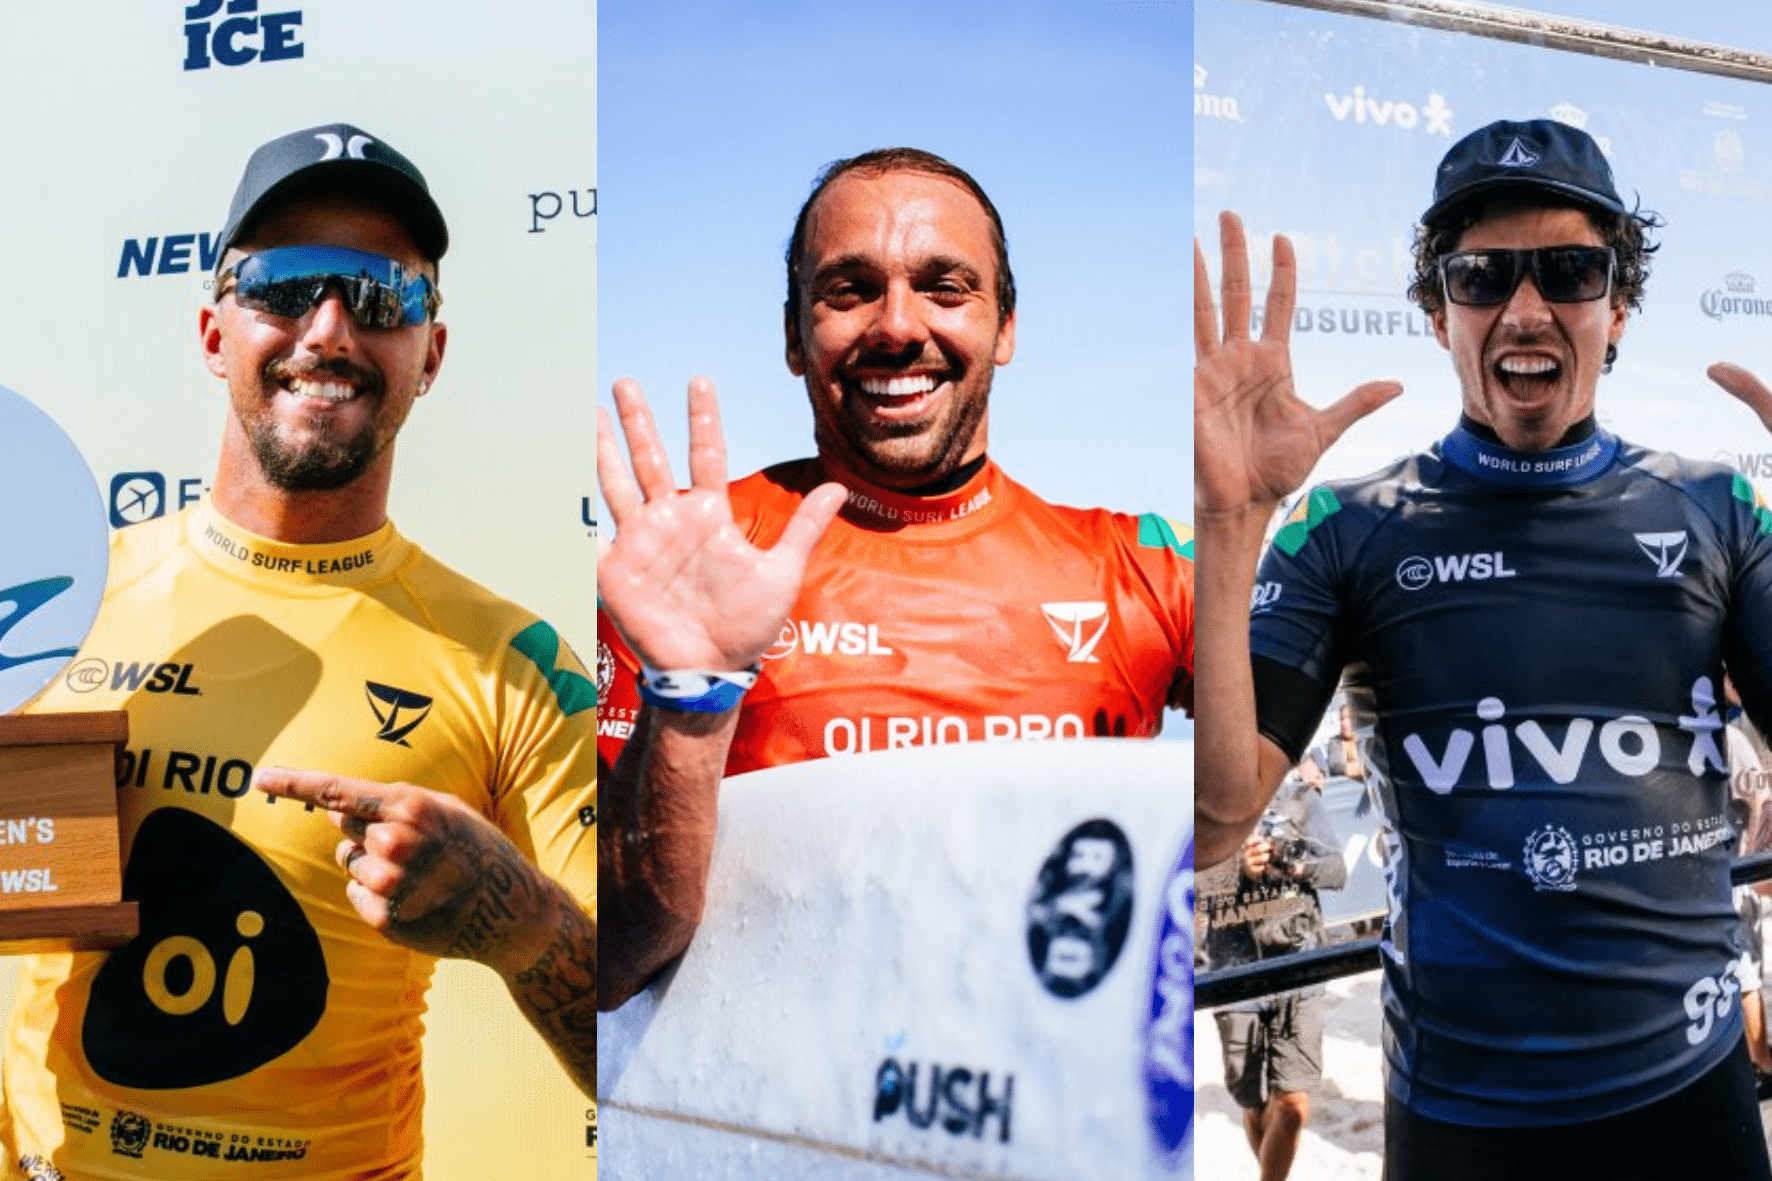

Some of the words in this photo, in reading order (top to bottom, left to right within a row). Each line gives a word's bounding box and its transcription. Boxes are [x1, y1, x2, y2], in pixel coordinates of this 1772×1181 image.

[183, 10, 304, 71] ICE
[1325, 86, 1419, 130] vivo
[1479, 453, 1530, 472] WORLD
[1534, 459, 1573, 473] SURF
[205, 526, 249, 561] WORLD
[251, 551, 302, 574] SURF
[306, 549, 375, 574] LEAGUE
[1434, 551, 1517, 582] WSL
[800, 621, 893, 656] WSL
[110, 661, 200, 696] WSL
[886, 715, 969, 751] RIO
[984, 713, 1085, 745] PRO
[1403, 697, 1661, 794] vivo
[163, 751, 253, 799] RIO
[1582, 825, 1664, 846] GOVERNO
[1671, 821, 1691, 835] DO
[1584, 845, 1629, 869] RIO
[1632, 840, 1664, 862] DE
[1, 867, 59, 893] WSL
[143, 910, 264, 1026] oi
[873, 1056, 1016, 1144] PUSH
[153, 1132, 190, 1153] RIO
[192, 1139, 220, 1159] DE
[231, 1133, 249, 1144] DO
